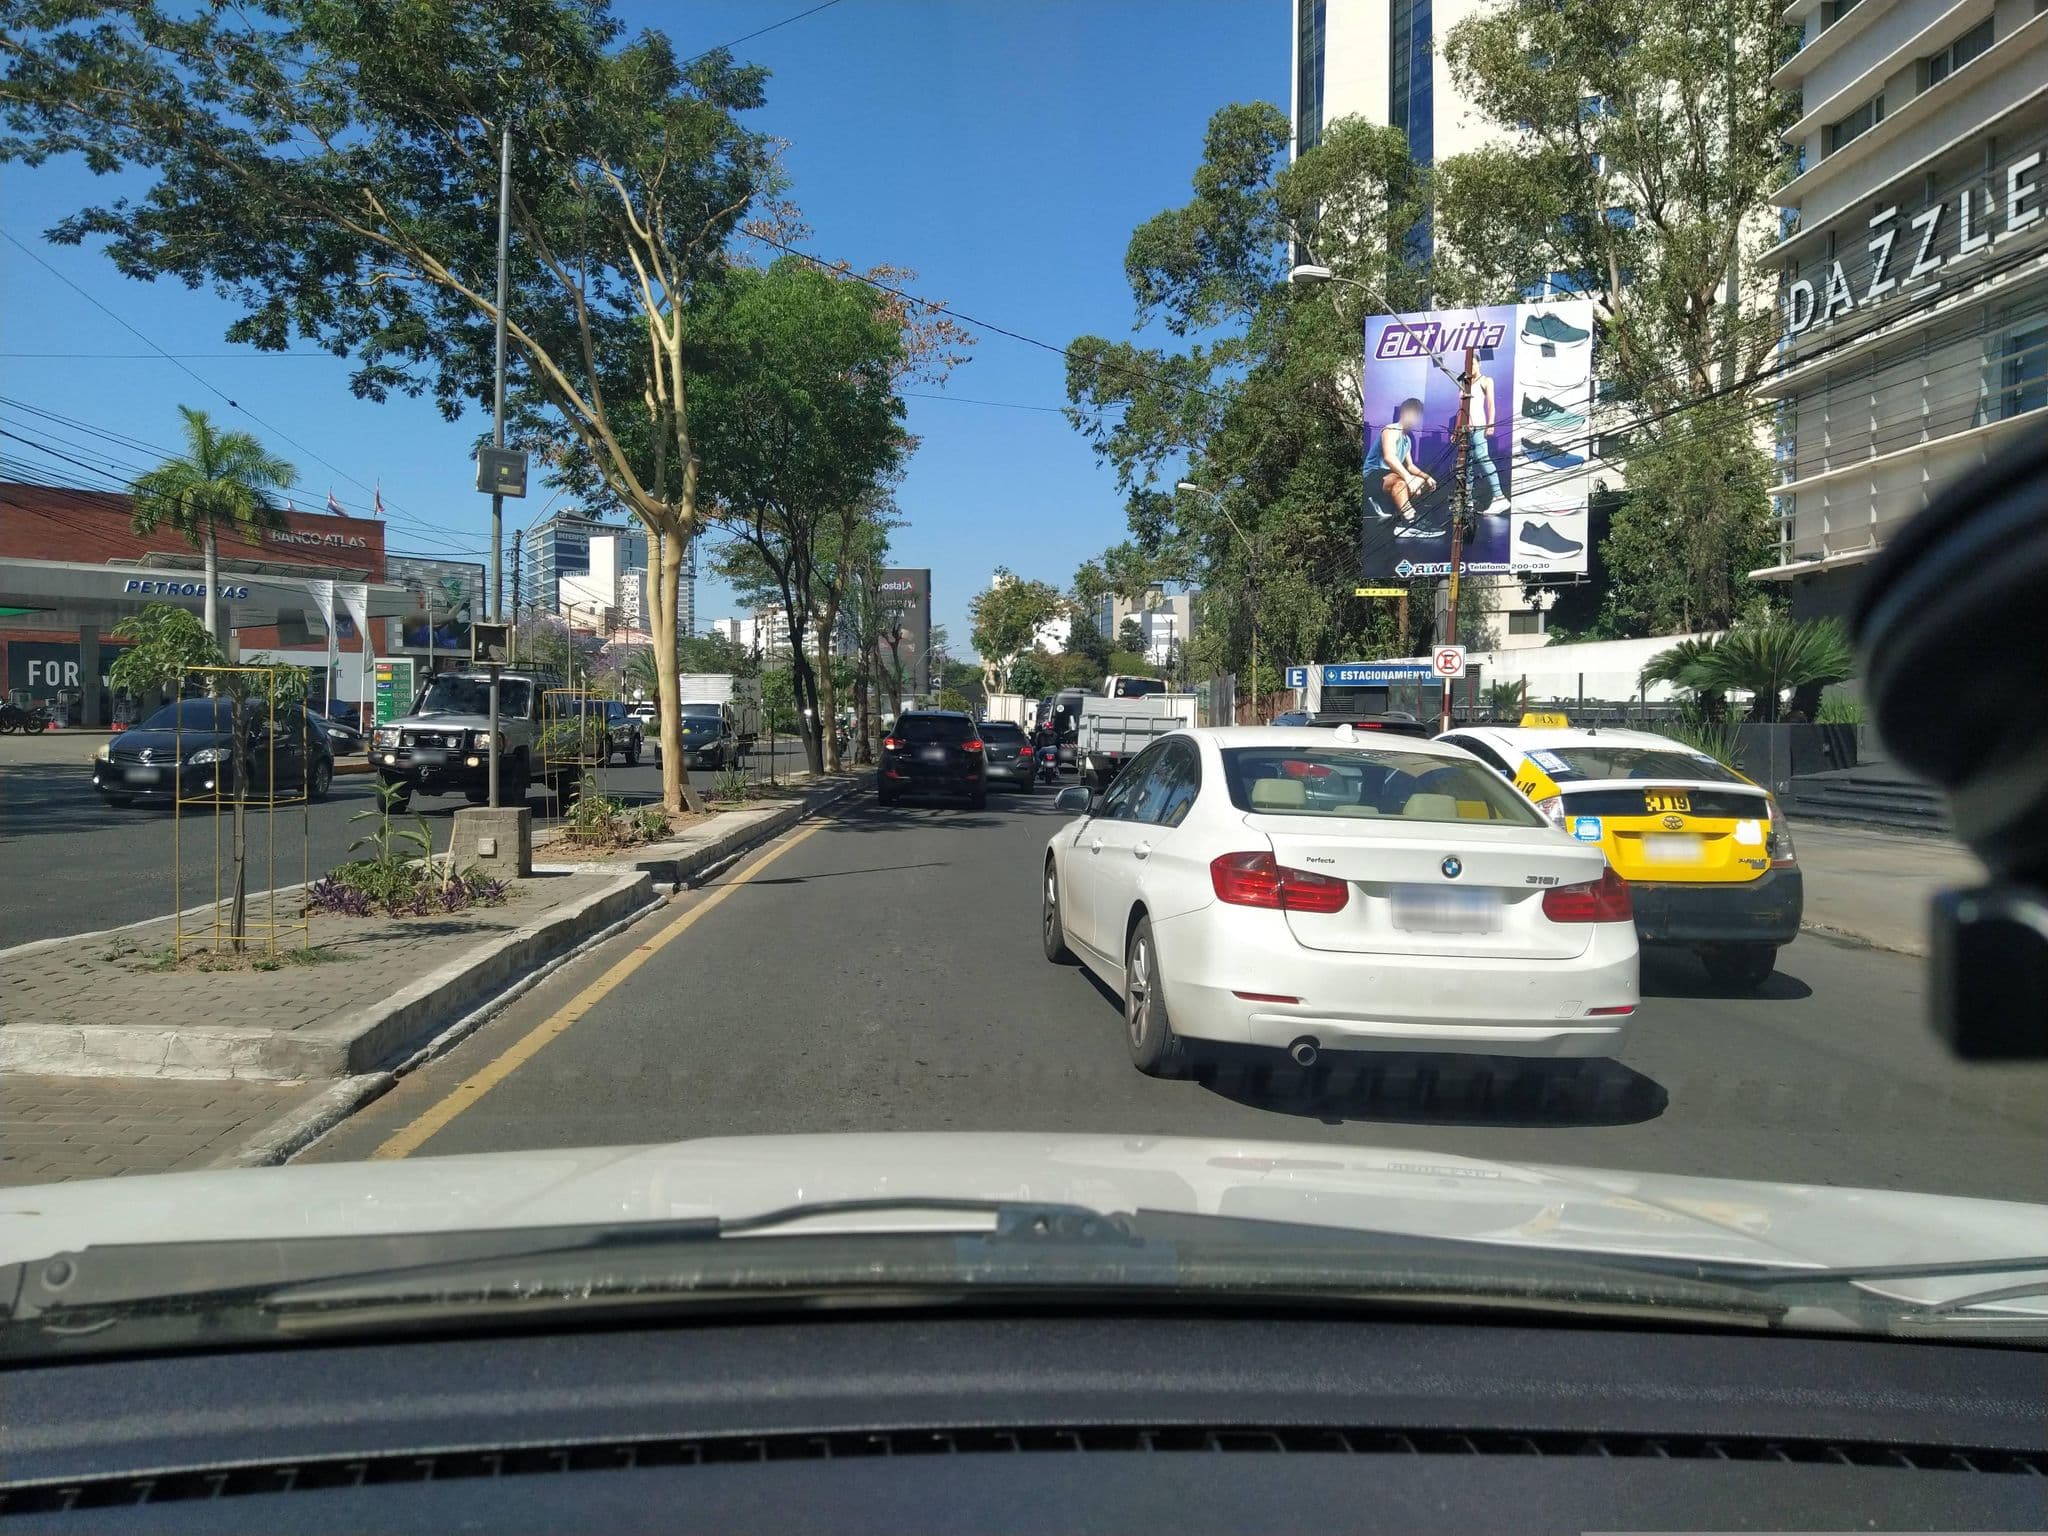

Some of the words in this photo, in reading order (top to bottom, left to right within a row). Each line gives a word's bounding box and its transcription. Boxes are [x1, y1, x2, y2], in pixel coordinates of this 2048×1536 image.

[1790, 151, 2047, 333] DAZZLE
[272, 530, 321, 545] BANCO
[323, 533, 366, 548] ATLAS
[124, 579, 249, 599] PETROBAS
[1292, 670, 1303, 686] E
[1340, 670, 1432, 681] ESTACIONAMIENTO
[1306, 856, 1336, 865] Perfecta
